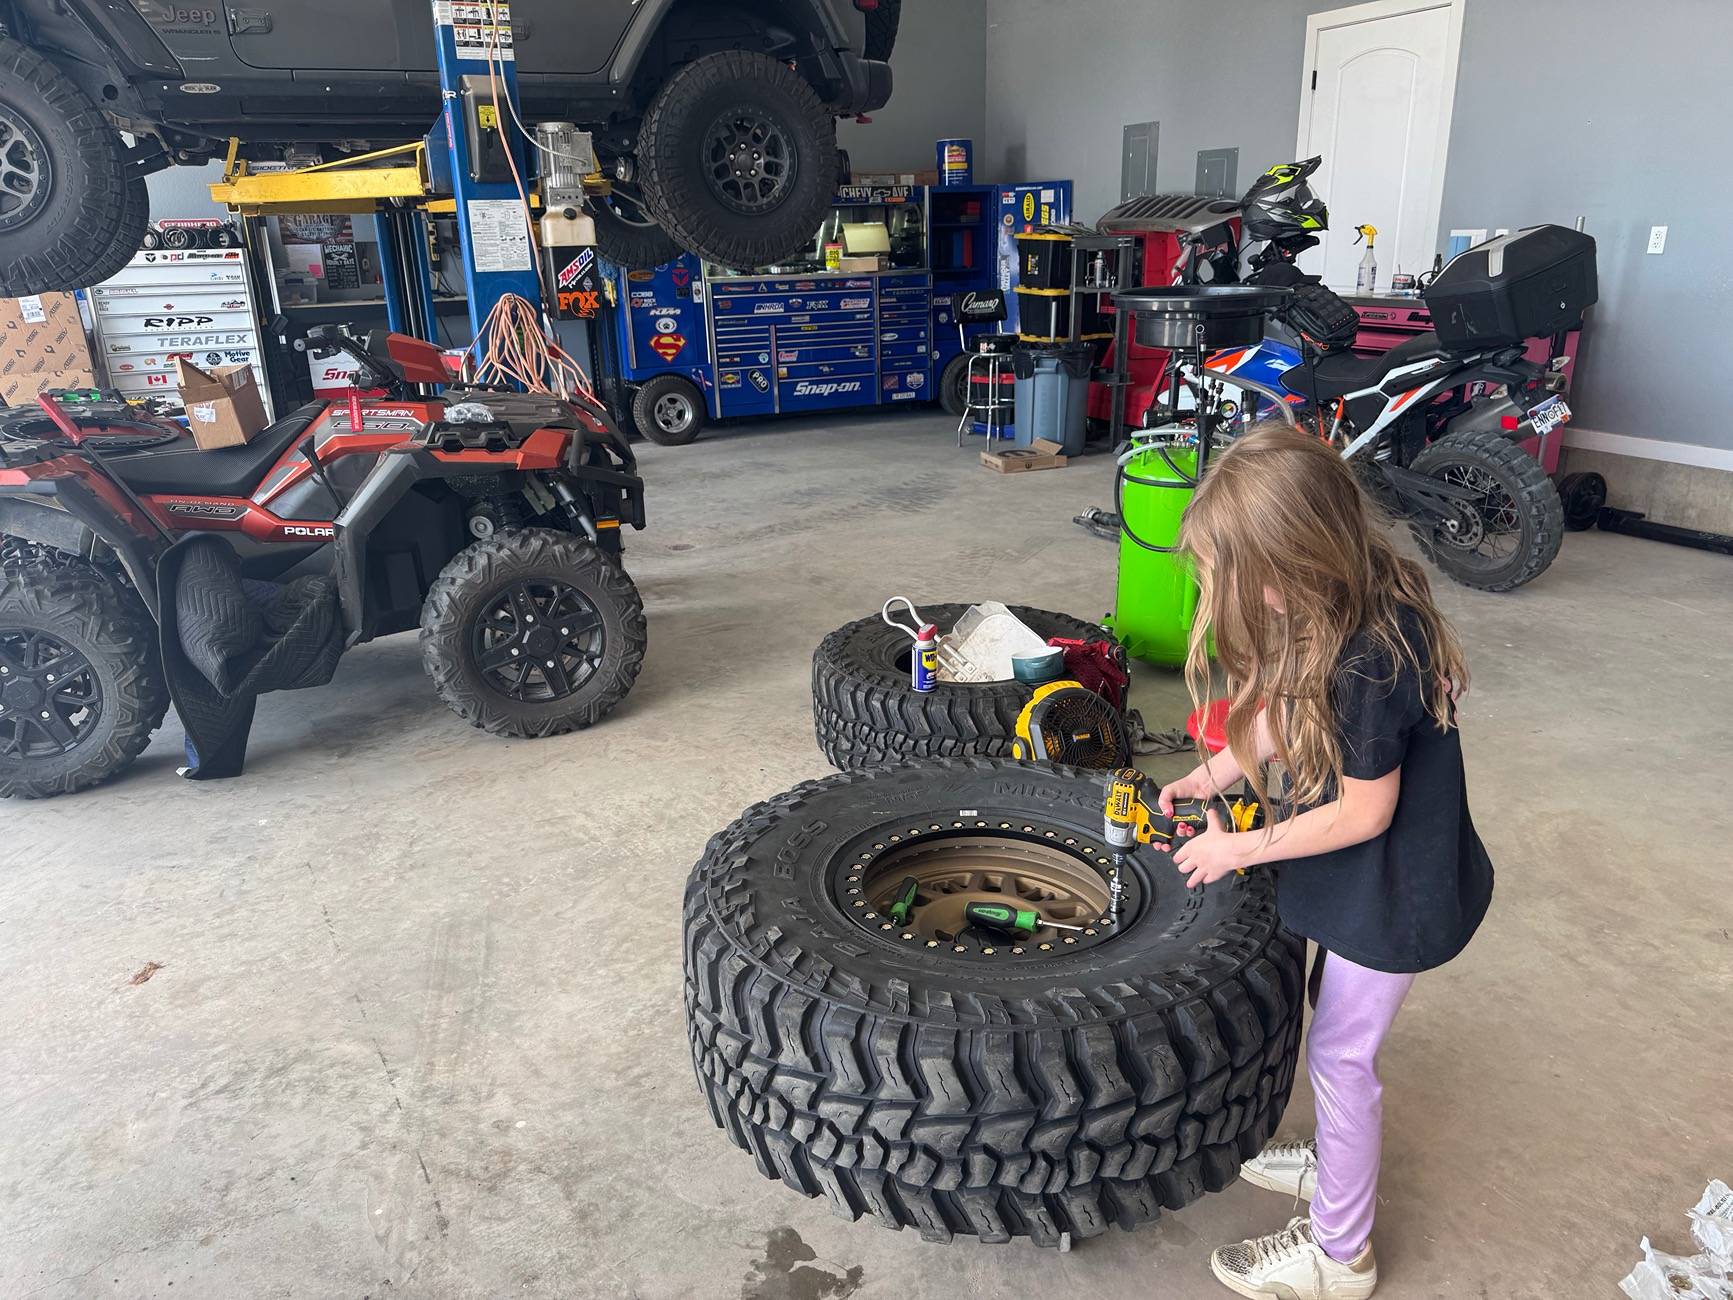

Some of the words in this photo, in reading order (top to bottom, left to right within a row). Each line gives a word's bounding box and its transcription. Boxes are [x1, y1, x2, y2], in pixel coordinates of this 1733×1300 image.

[162, 5, 216, 26] Jeep
[842, 186, 872, 198] CHEVY
[324, 244, 353, 254] MECHANIC
[558, 249, 594, 288] AMSOIL
[558, 292, 600, 314] FOX
[961, 292, 999, 313] Camaro
[144, 316, 214, 328] RIPP
[157, 334, 248, 347] TERAFLEX
[752, 371, 768, 389] PRO
[794, 382, 861, 396] Snap-on
[1113, 790, 1123, 816] DEWALT
[774, 819, 830, 880] BOSS
